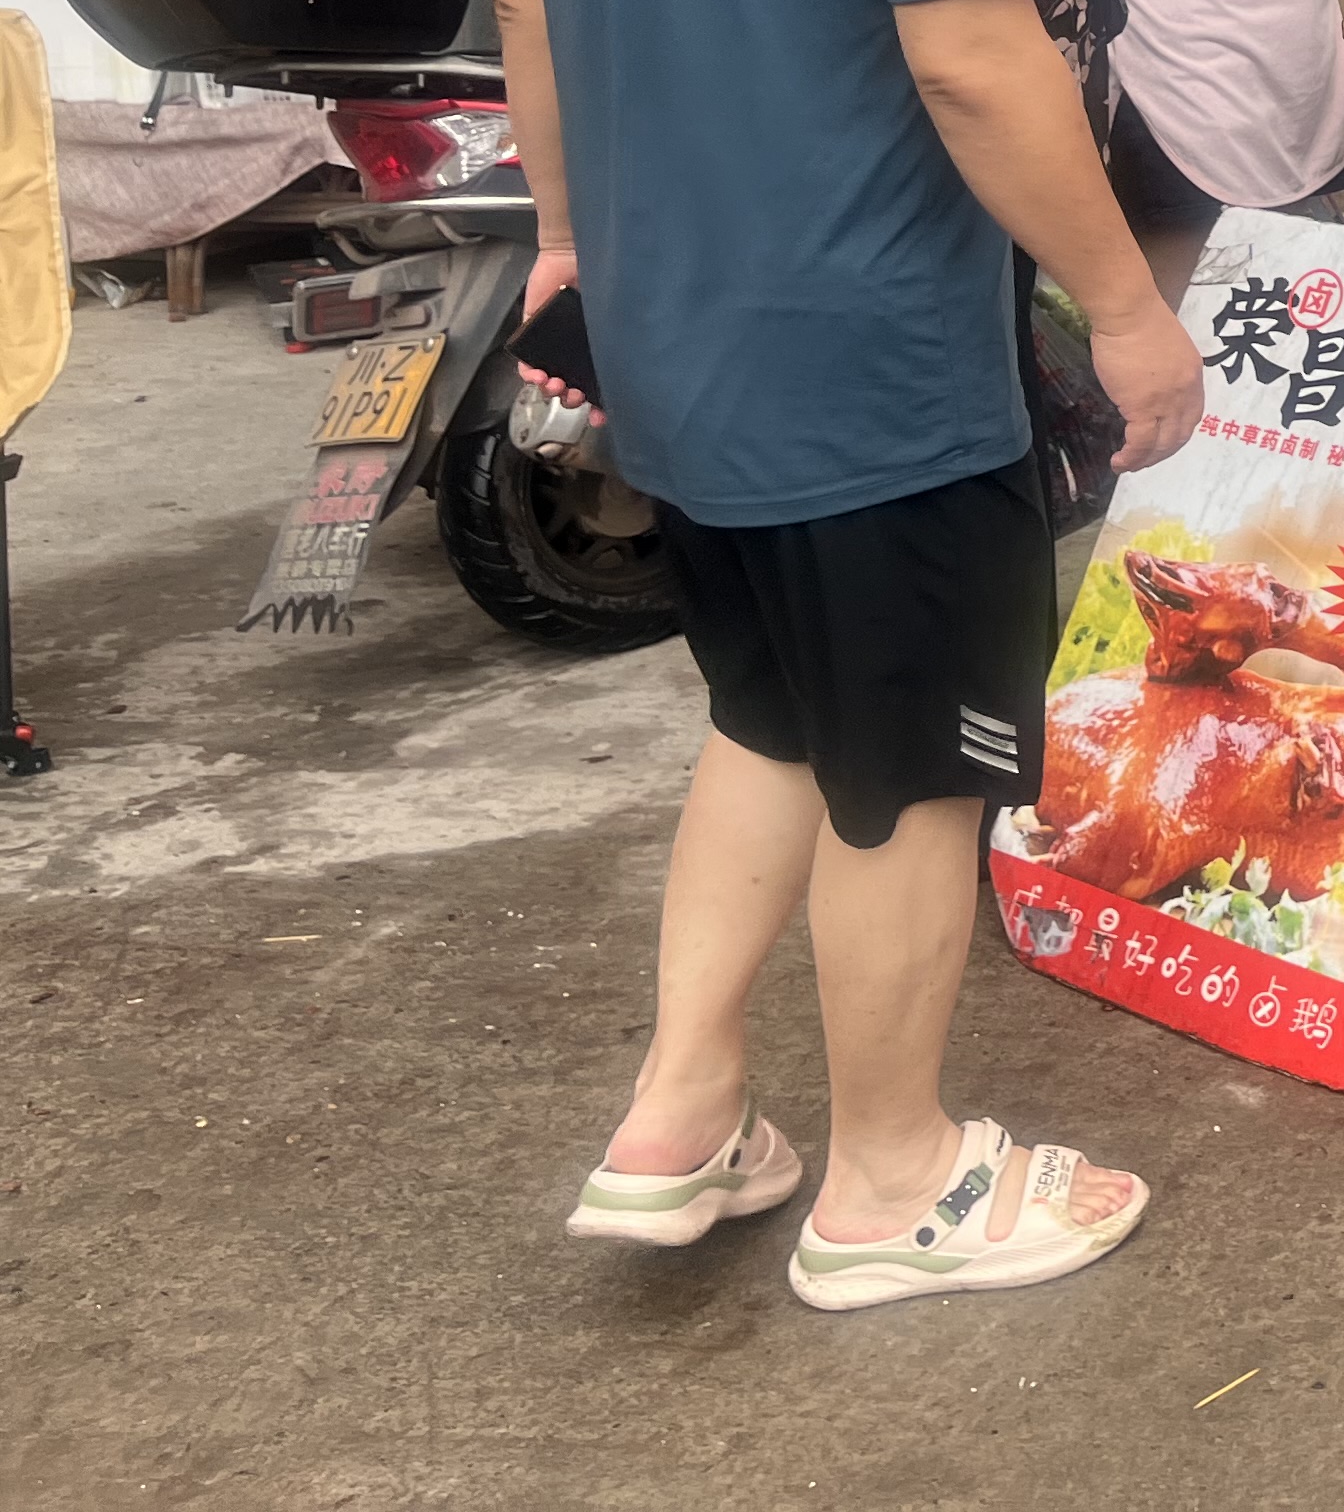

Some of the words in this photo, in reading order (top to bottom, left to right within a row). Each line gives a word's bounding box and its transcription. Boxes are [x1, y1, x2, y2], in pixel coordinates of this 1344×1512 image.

[1297, 275, 1339, 322] 卤
[1199, 414, 1321, 461] 纯中草药卤制
[1033, 1148, 1060, 1198] SENMA
